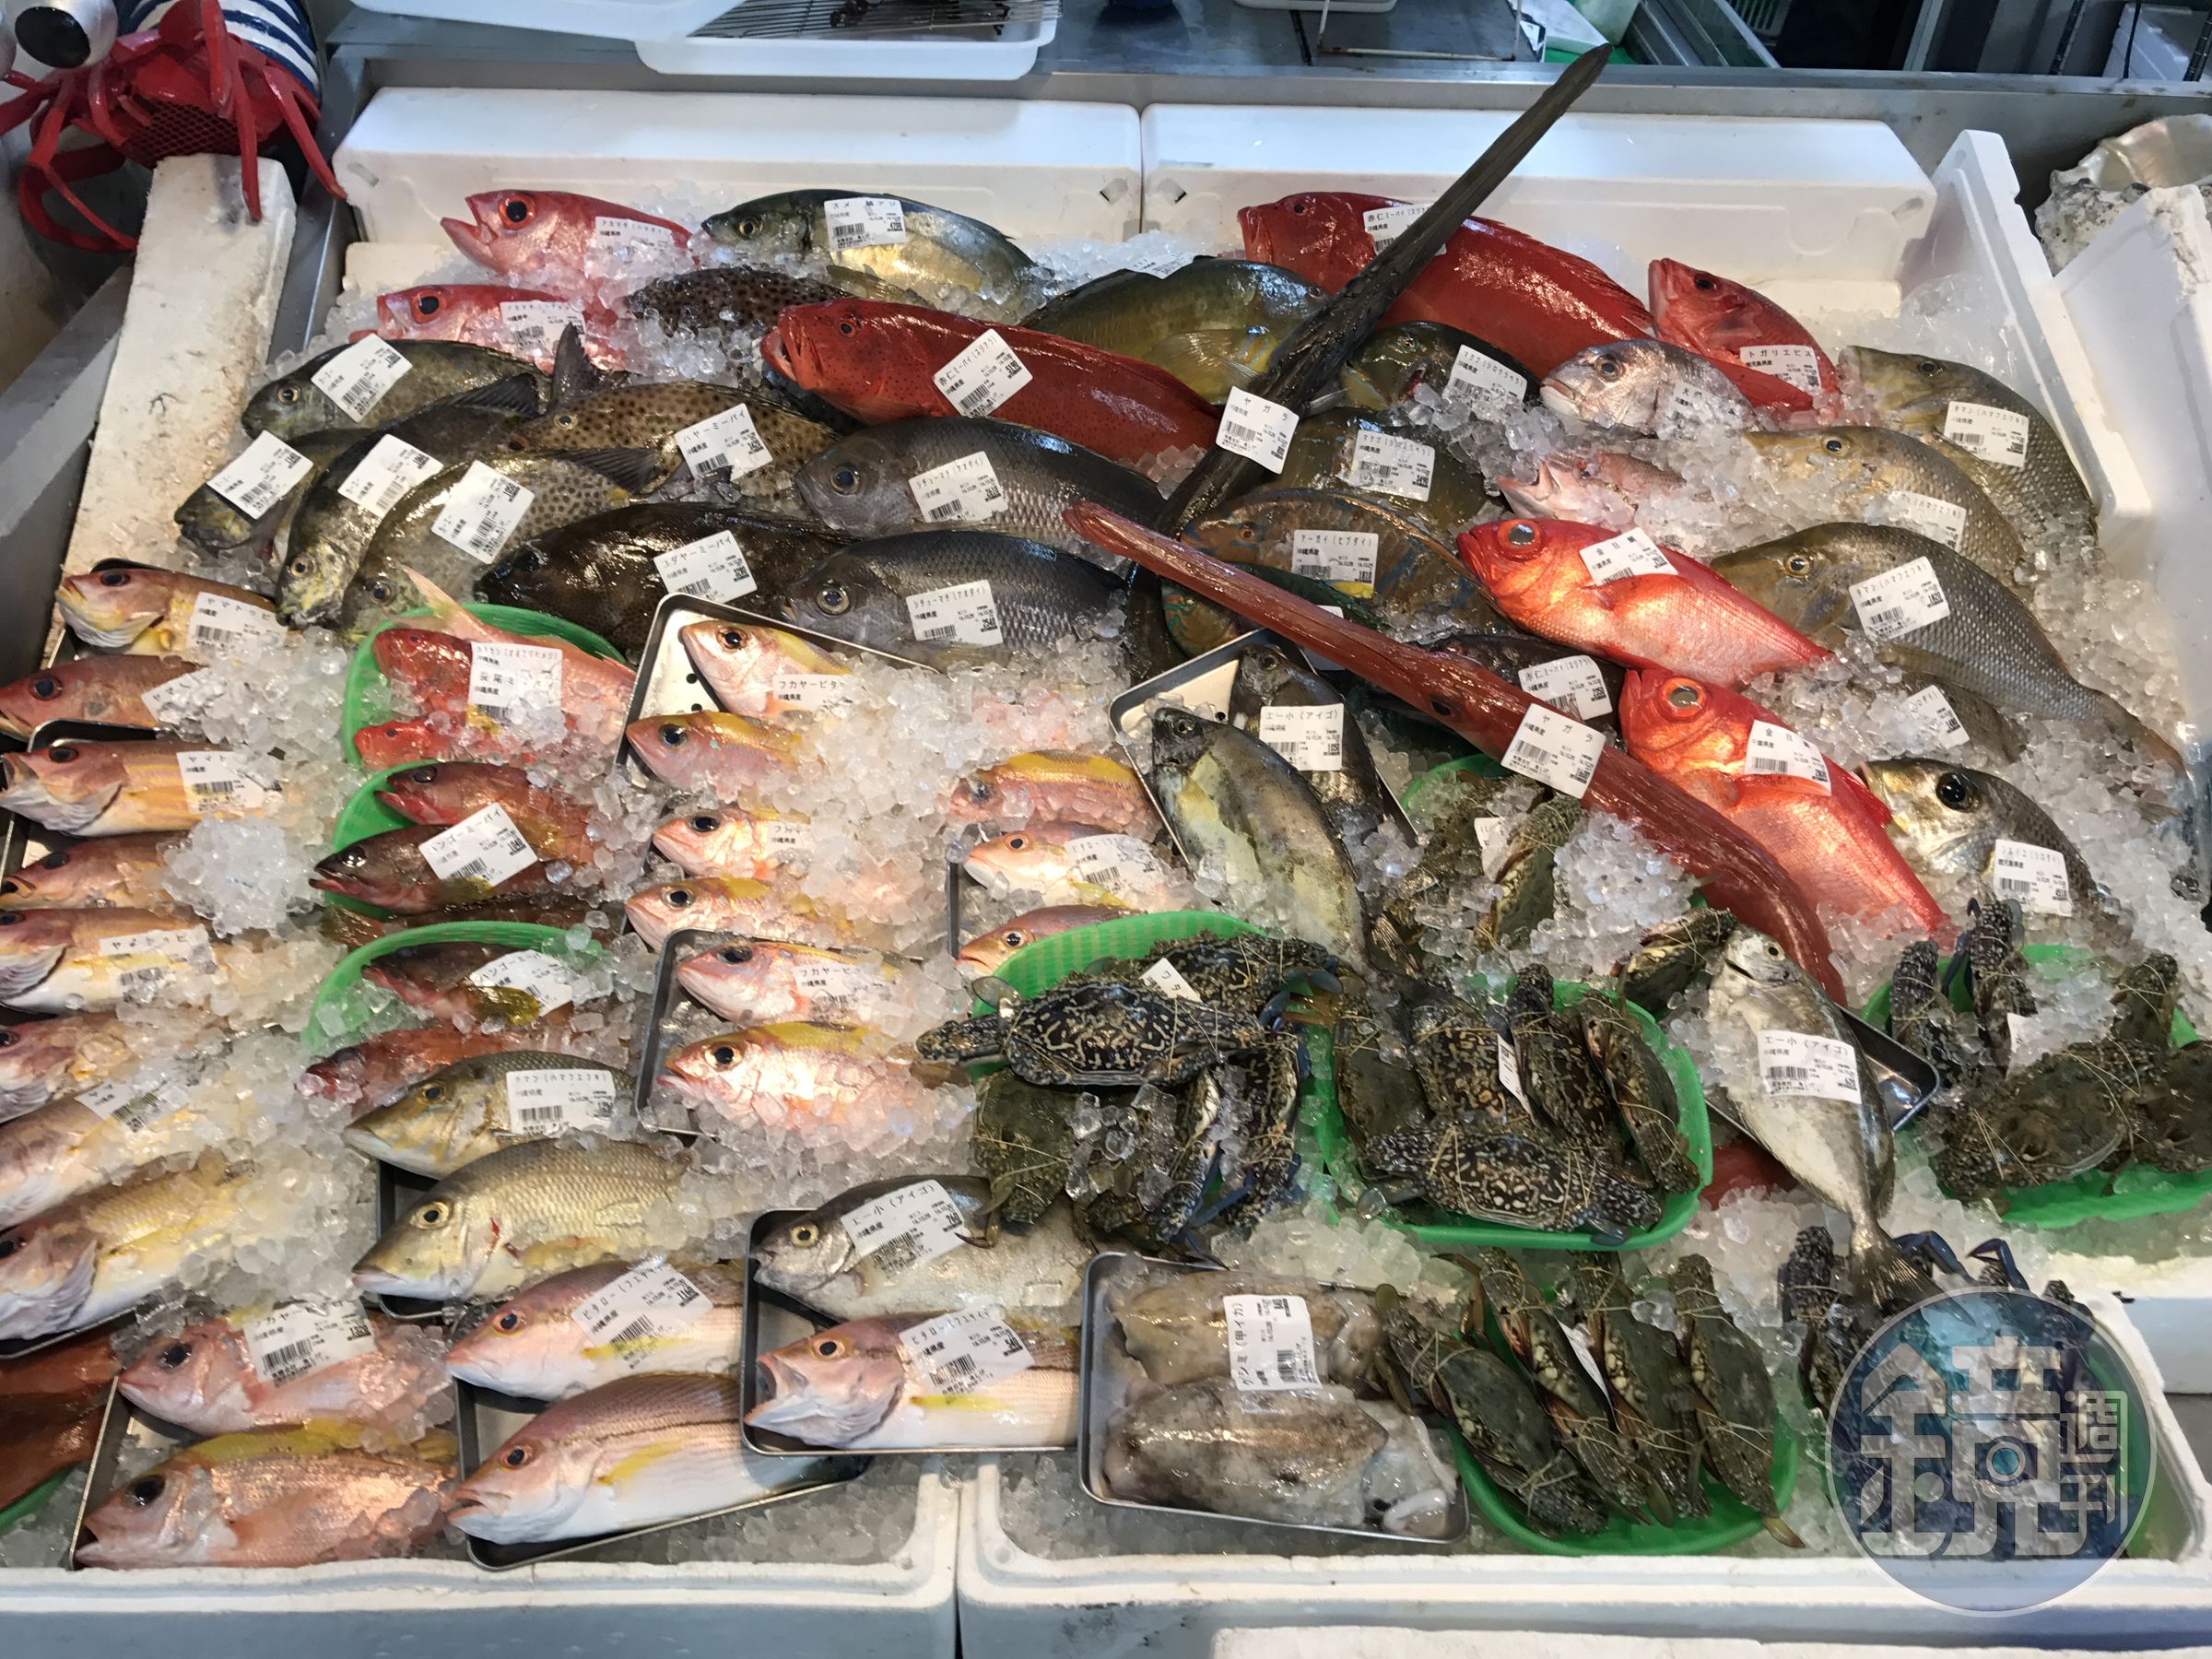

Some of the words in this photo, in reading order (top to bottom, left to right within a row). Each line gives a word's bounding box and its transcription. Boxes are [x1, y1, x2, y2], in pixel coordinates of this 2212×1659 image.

[1540, 713, 1594, 744] ヤガラ
[946, 1212, 960, 1223] 760
[677, 1286, 696, 1301] 1160
[1006, 1338, 1019, 1350] 540
